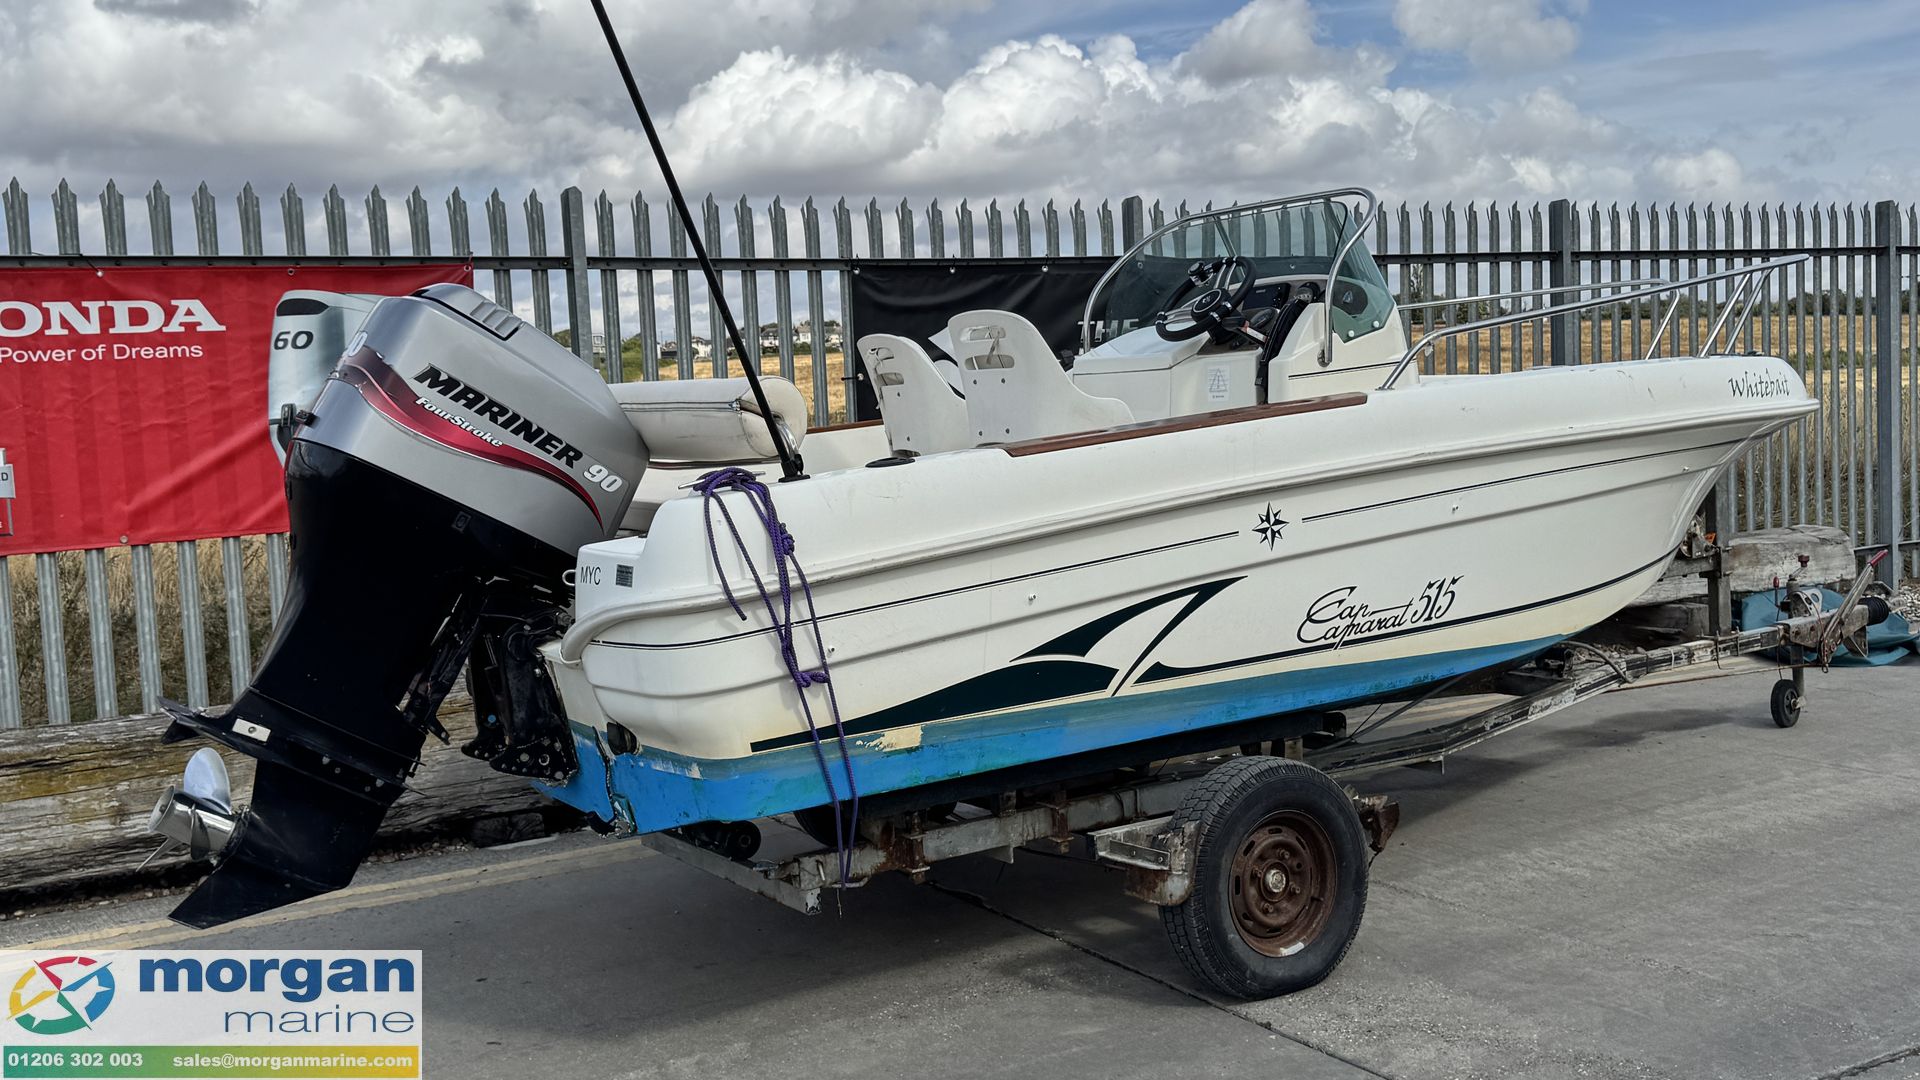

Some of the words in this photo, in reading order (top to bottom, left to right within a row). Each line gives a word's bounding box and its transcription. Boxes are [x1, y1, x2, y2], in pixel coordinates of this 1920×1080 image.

[0, 346, 76, 363] Power
[81, 344, 107, 360] of
[113, 343, 204, 360] Dreams
[273, 331, 314, 350] 60
[1728, 368, 1790, 398] Whitebait
[412, 363, 584, 469] MARINER
[583, 464, 624, 493] 90
[415, 396, 504, 447] FourStroke
[580, 566, 602, 585] MYC
[1297, 597, 1414, 644] Camarat
[1411, 575, 1464, 624] 515
[1306, 586, 1370, 646] Cap
